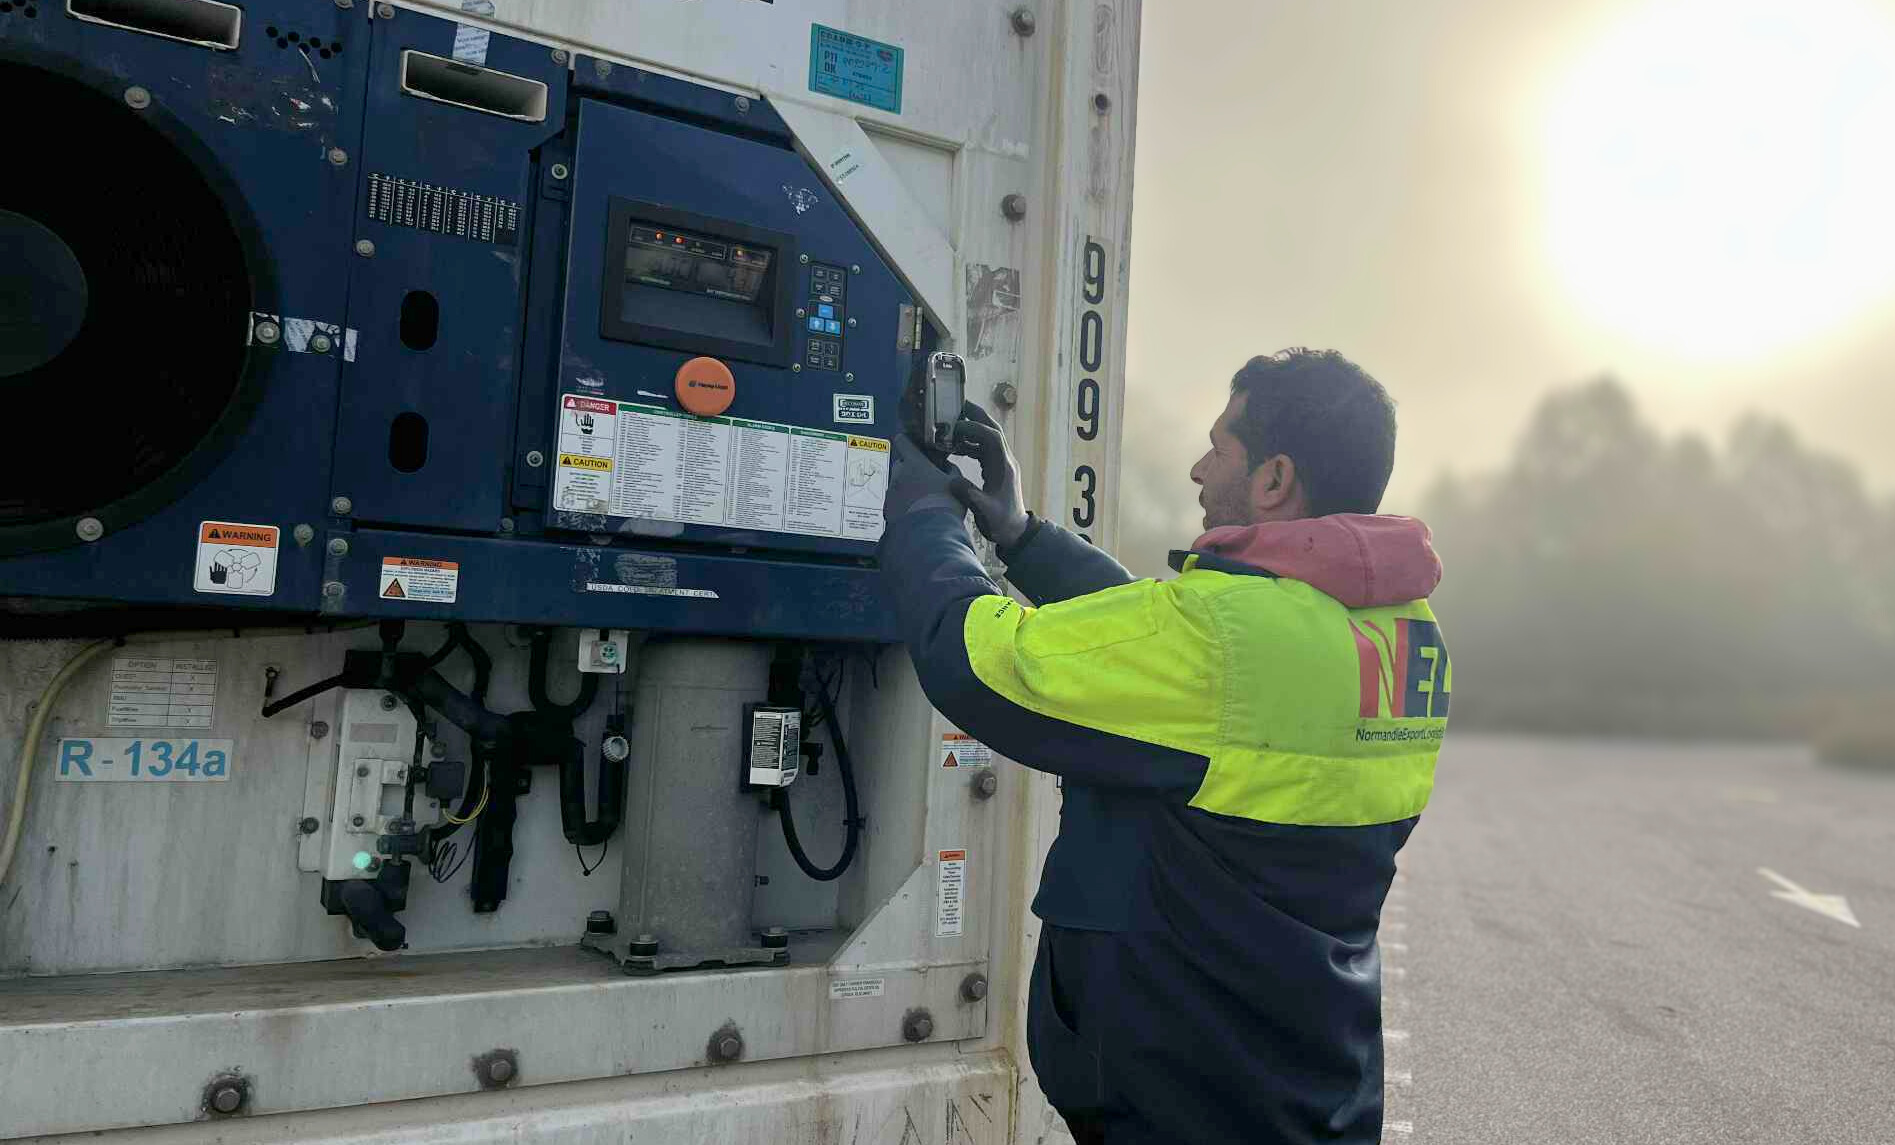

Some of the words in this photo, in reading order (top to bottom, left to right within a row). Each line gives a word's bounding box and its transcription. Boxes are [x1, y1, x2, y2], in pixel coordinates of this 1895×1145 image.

[824, 50, 837, 63] PTI
[824, 62, 837, 74] OK
[579, 400, 610, 412] DANGER
[858, 440, 887, 451] CAUTION
[573, 457, 608, 469] CAUTION
[223, 530, 271, 542] WARNING
[591, 584, 614, 592] USDA
[128, 660, 158, 670] OPTION
